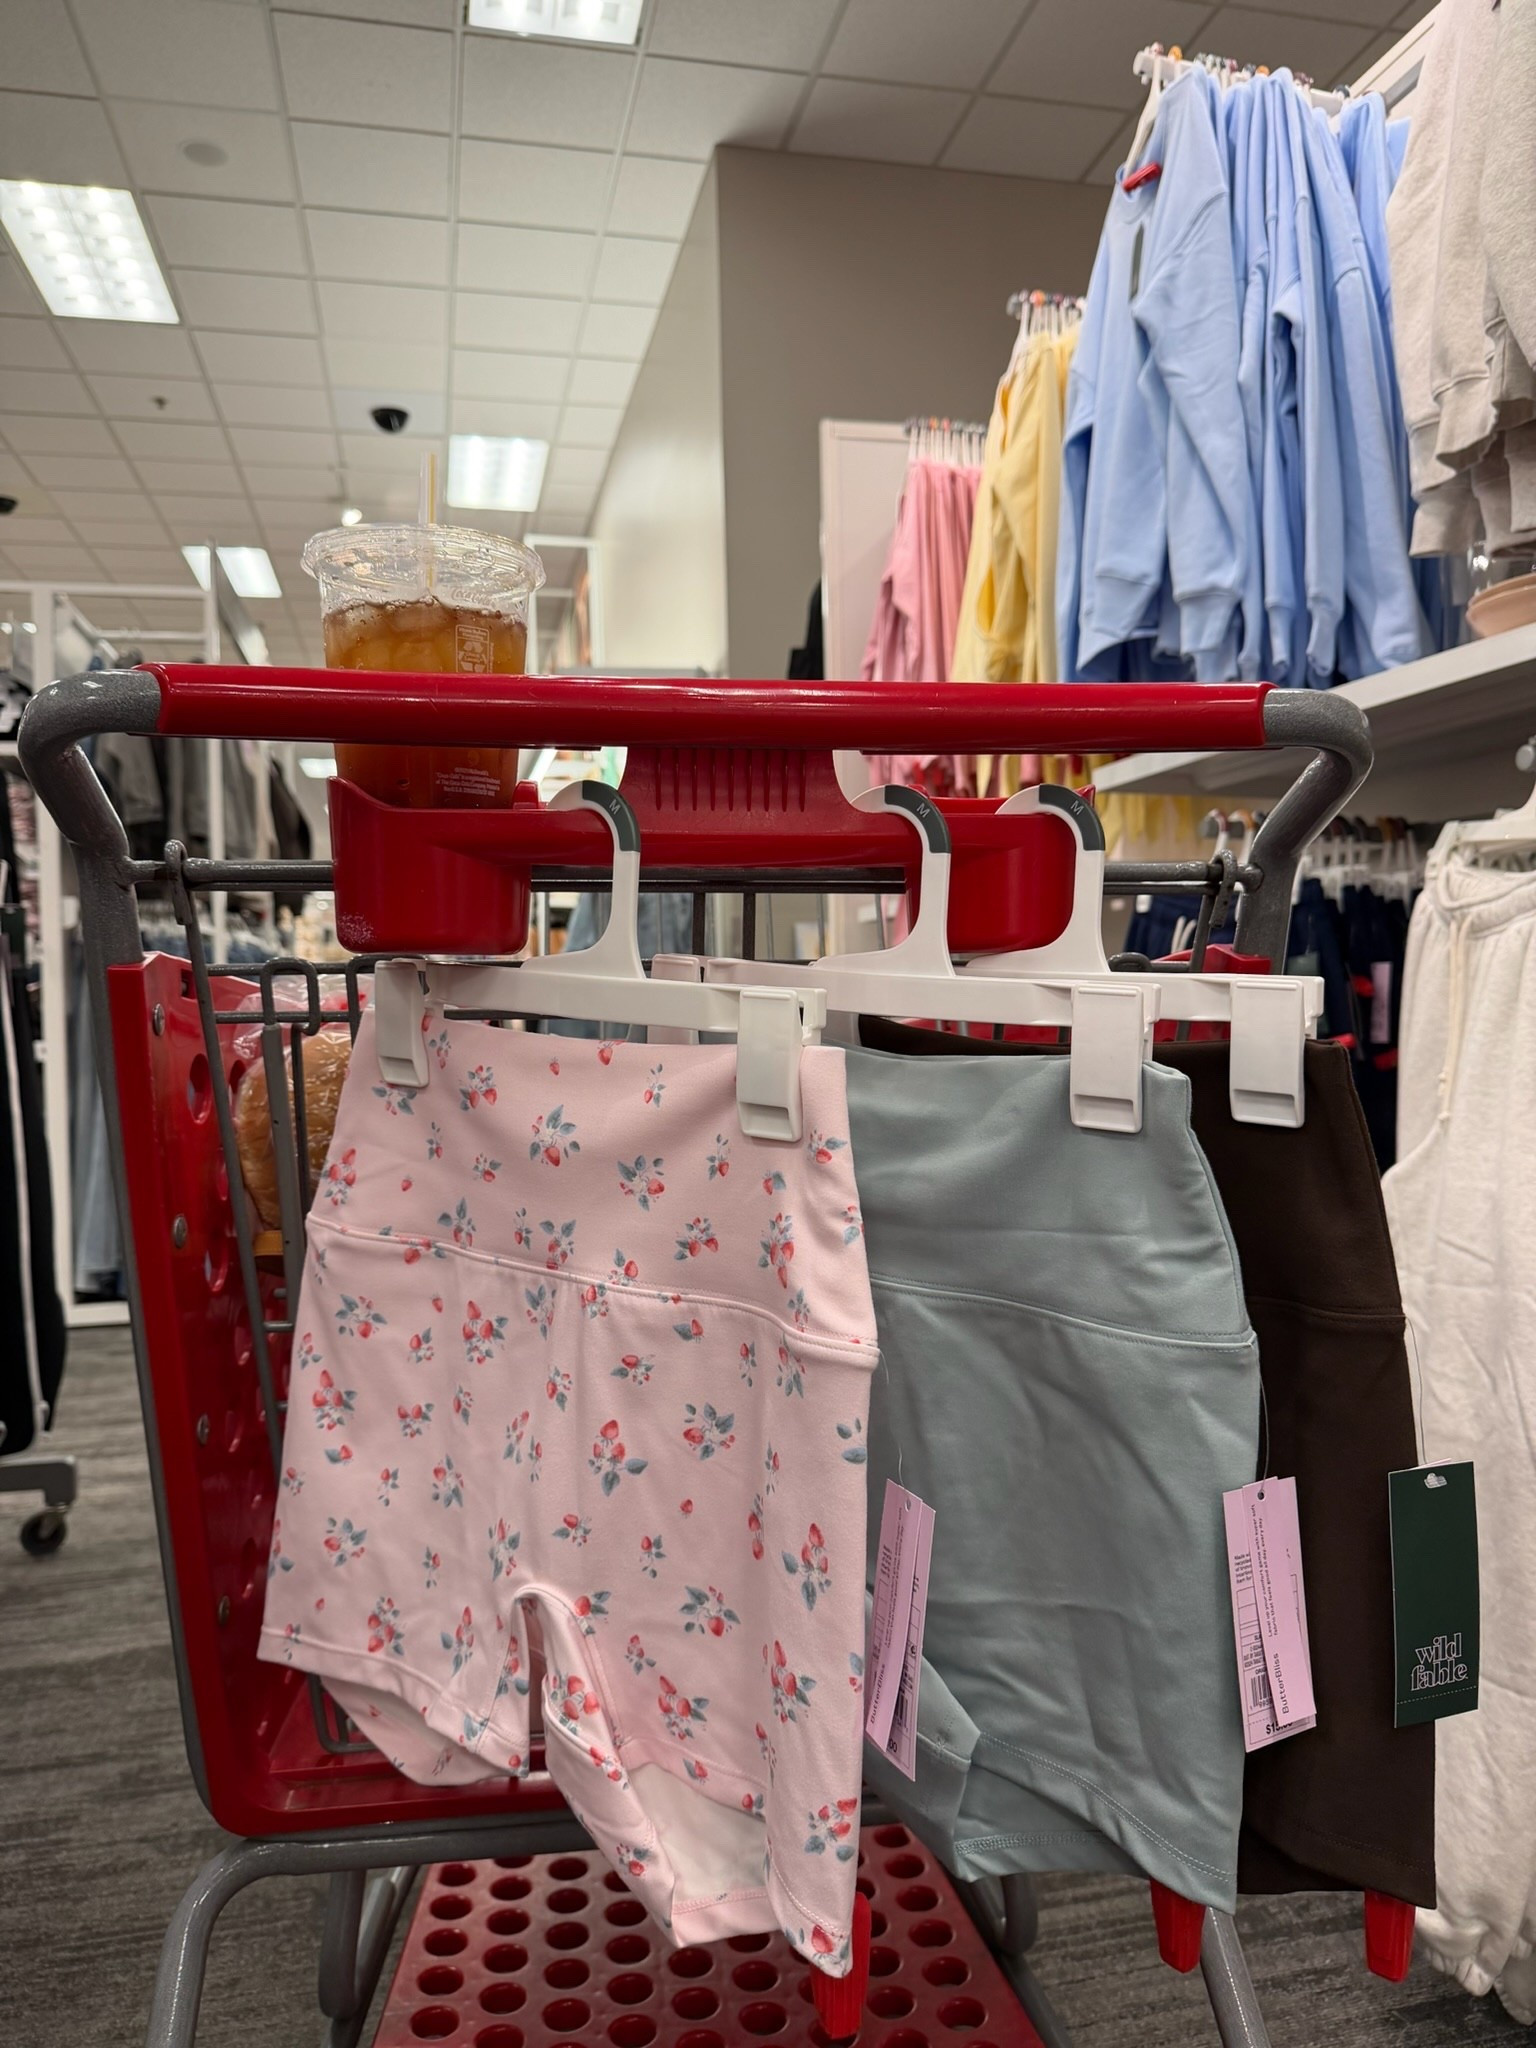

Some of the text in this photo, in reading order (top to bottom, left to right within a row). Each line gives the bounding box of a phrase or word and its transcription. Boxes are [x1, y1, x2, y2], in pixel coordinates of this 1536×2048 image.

[609, 799, 621, 815] M
[916, 803, 930, 818] M
[1070, 800, 1084, 815] M
[1415, 1632, 1462, 1665] wild
[1273, 1653, 1290, 1715] ButterBliss
[1411, 1658, 1468, 1691] fable
